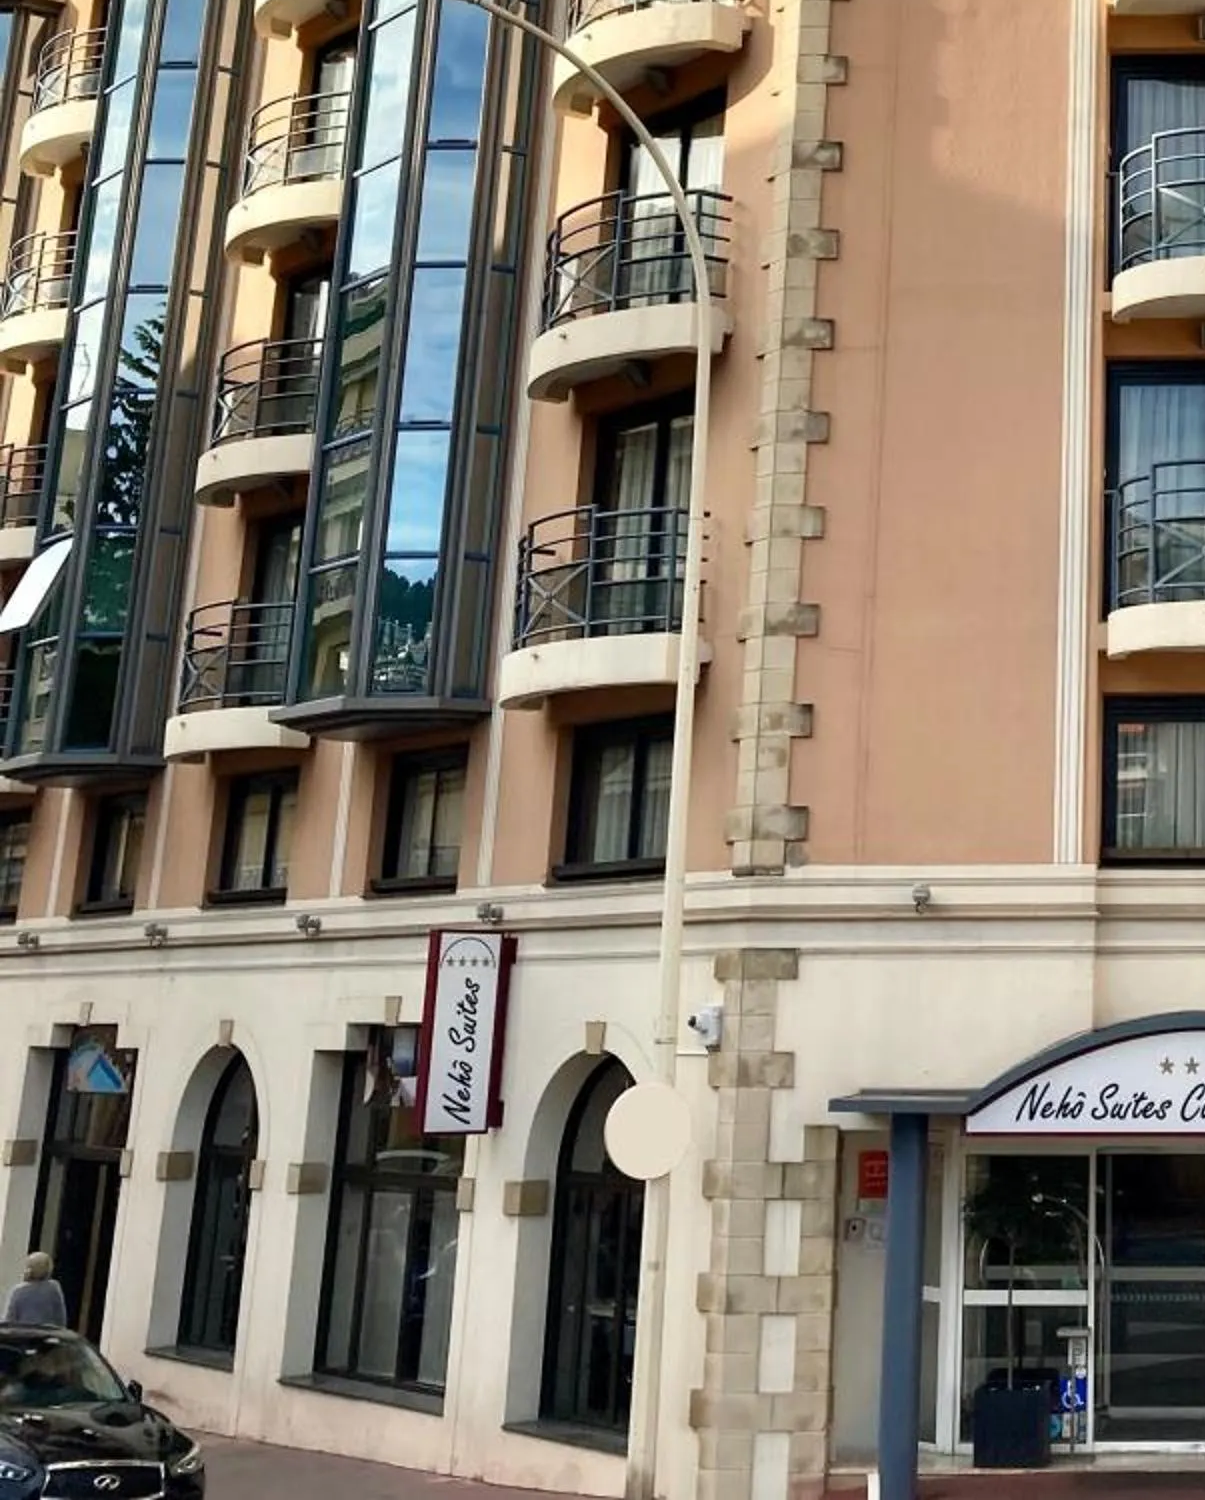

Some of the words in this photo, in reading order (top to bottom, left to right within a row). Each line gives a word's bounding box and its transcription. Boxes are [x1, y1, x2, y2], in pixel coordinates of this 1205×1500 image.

[447, 977, 481, 1054] Suites
[442, 1058, 473, 1126] Nehô
[1014, 1081, 1083, 1123] Nehô
[1091, 1083, 1173, 1121] Suites
